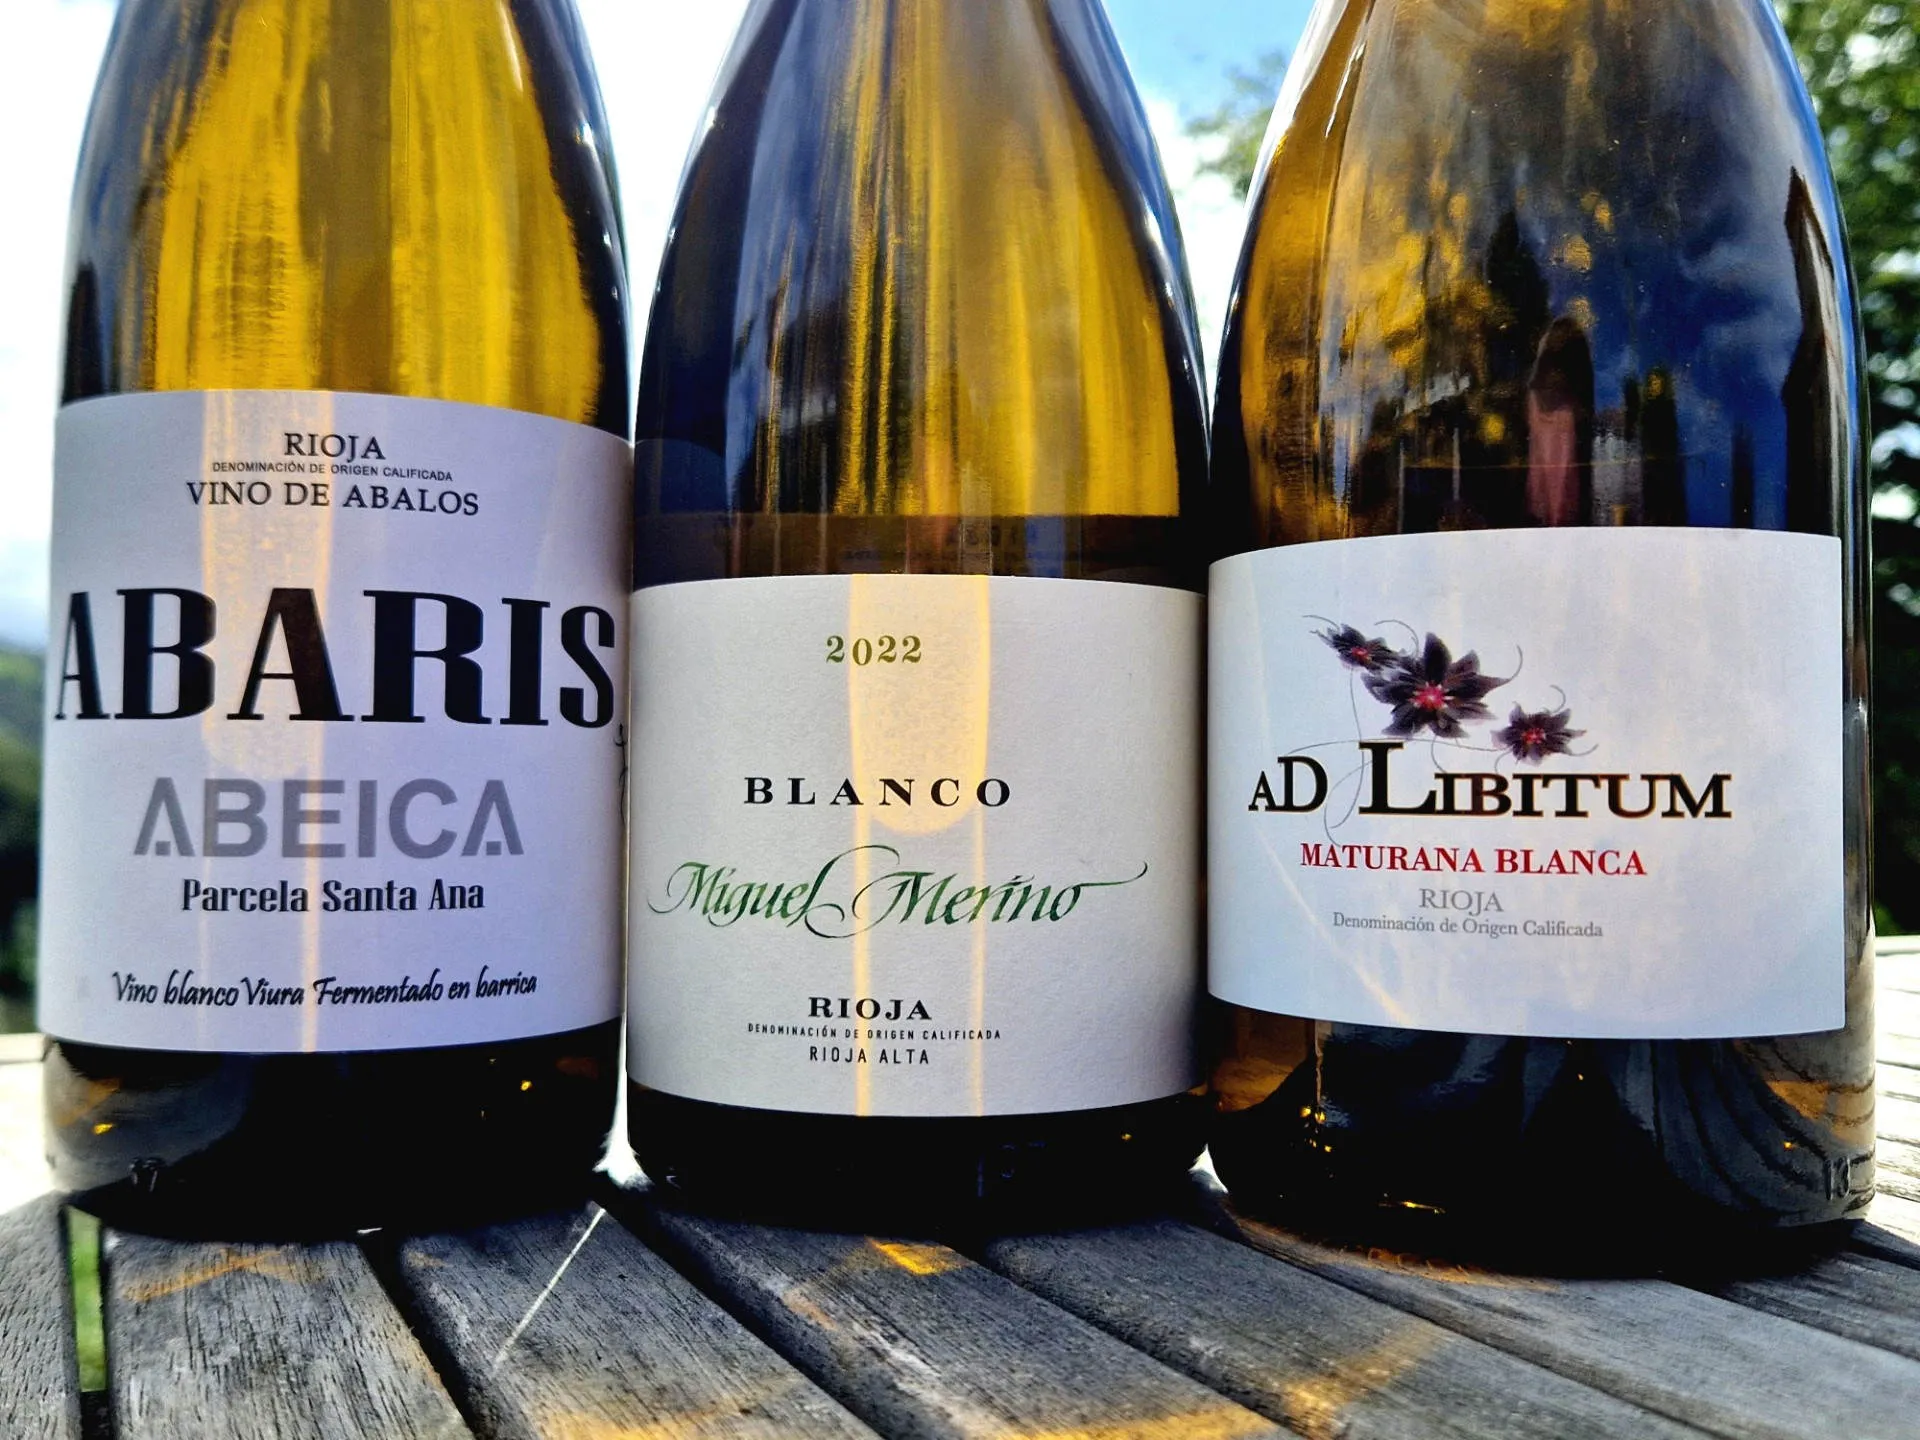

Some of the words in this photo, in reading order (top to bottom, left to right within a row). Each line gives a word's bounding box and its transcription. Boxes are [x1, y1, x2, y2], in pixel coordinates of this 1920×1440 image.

[284, 433, 386, 461] RIOJA
[213, 461, 304, 472] DENOMINACIÓN
[309, 463, 326, 474] DE
[331, 462, 378, 475] ORIGEN
[383, 467, 453, 481] CALIFICADA
[187, 482, 271, 505] VINO
[284, 483, 329, 506] DE
[343, 485, 478, 516] ABALOS
[54, 587, 616, 729] ABARIS
[827, 635, 921, 665] 2022
[744, 777, 1010, 807] BLANCO
[1248, 756, 1327, 812] AD
[1359, 740, 1732, 818] LIBITUM
[134, 778, 524, 859] ABEICA
[1301, 843, 1484, 872] MATURANA
[1496, 849, 1646, 876] BLANCA
[183, 879, 308, 912] Parcela
[322, 880, 416, 912] Santa
[428, 879, 484, 910] Ana
[648, 845, 904, 938] Miguel
[850, 863, 1148, 937] Merino
[1419, 889, 1503, 914] RIOJA
[1334, 912, 1435, 933] Denominación
[1440, 918, 1457, 932] de
[1462, 915, 1518, 939] Origen
[1523, 920, 1602, 937] Calificada
[112, 972, 158, 1003] Vino
[164, 969, 239, 1006] blanco
[240, 972, 305, 1006] Viura
[313, 968, 443, 1005] Fermentado
[448, 982, 470, 999] en
[476, 965, 537, 998] barrica
[809, 997, 931, 1020] RIOJA
[747, 1023, 837, 1038] DENOMINACIÓN
[844, 1028, 860, 1039] DE
[867, 1029, 914, 1040] ORIGEN
[923, 1030, 1000, 1040] CALIFICADA
[810, 1046, 866, 1063] RIOJA
[879, 1049, 928, 1064] ALTA
